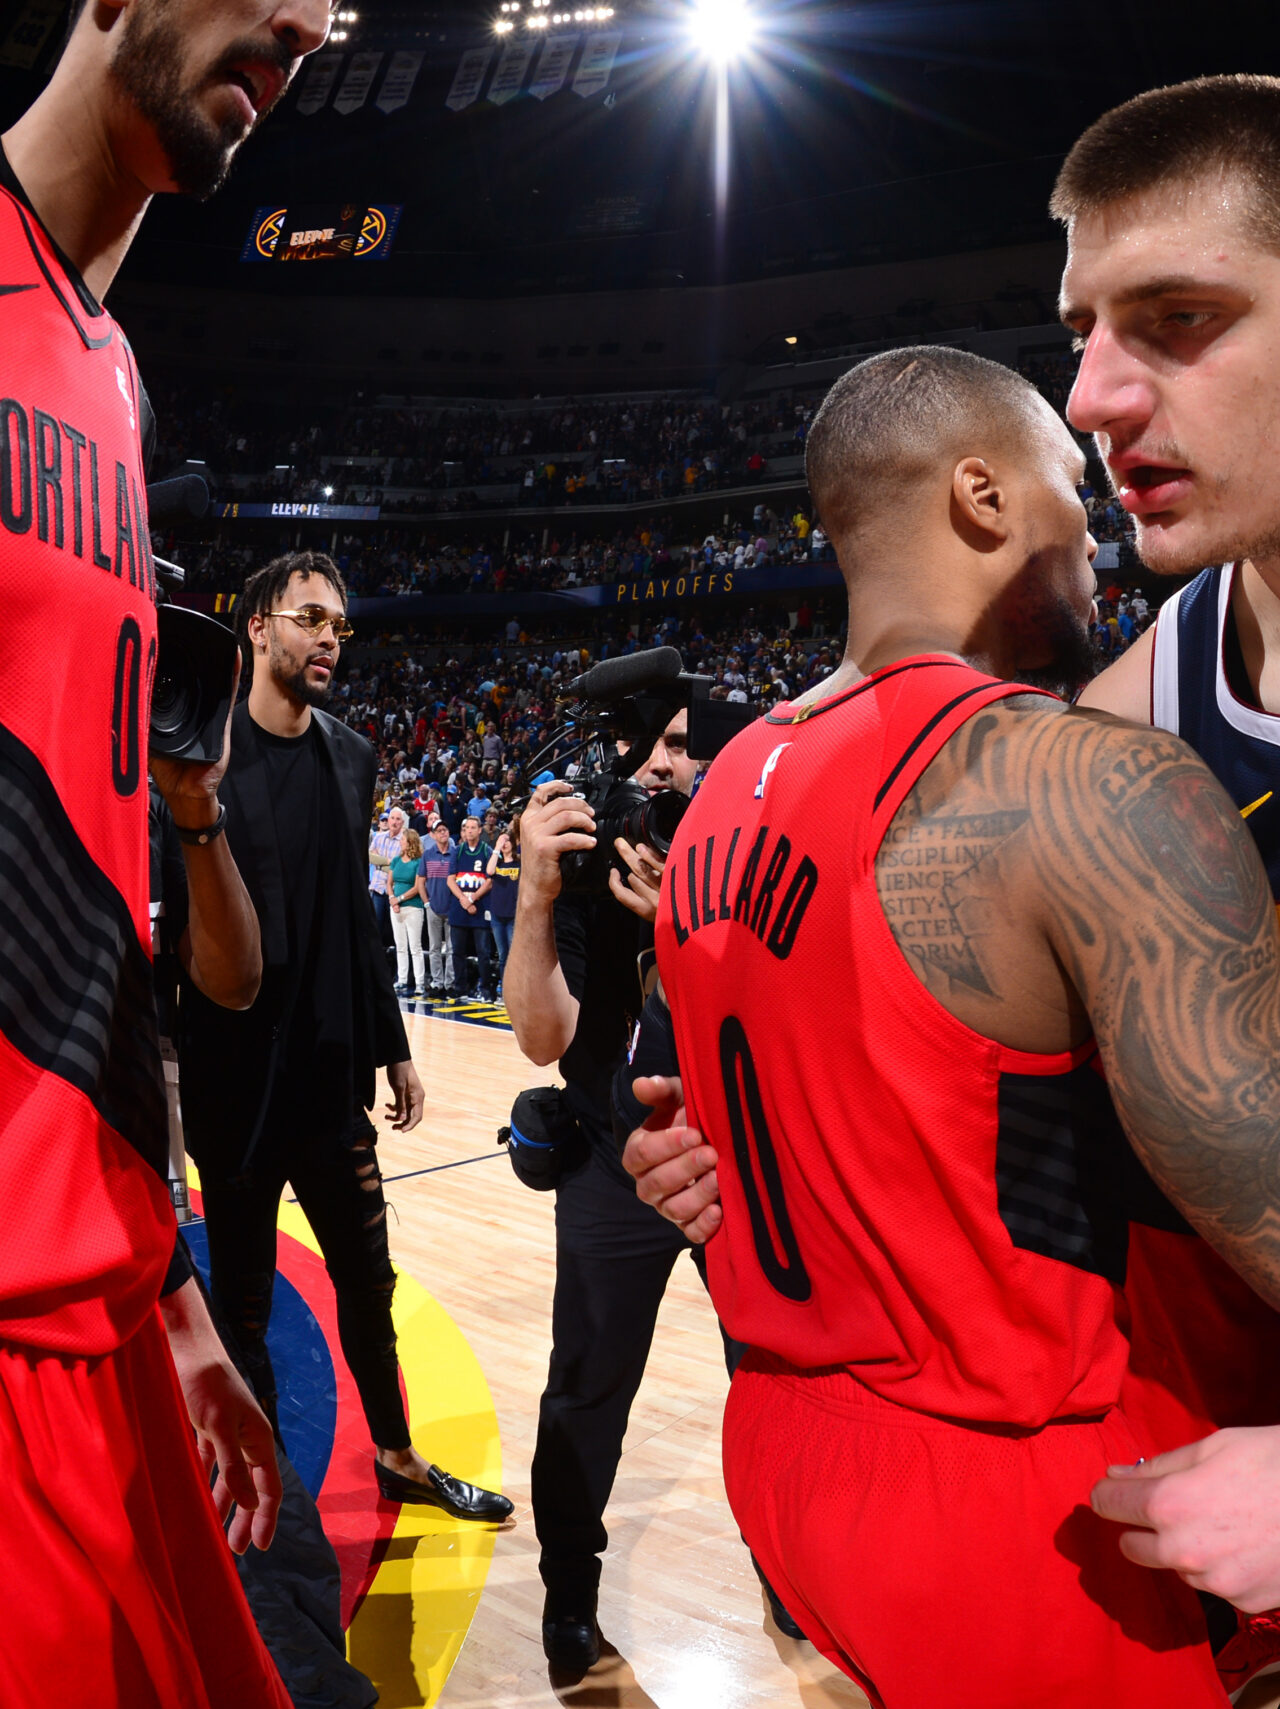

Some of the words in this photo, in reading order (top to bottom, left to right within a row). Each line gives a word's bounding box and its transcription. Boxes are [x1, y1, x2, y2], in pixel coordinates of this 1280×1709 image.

[0, 397, 156, 601] ORTLAN
[616, 573, 734, 602] PLAYOFFS
[877, 844, 992, 869] ISCIPLIN
[671, 826, 818, 960] LILLARD
[878, 870, 955, 892] IENCE
[884, 895, 937, 916] SITY
[719, 1015, 811, 1302] 0
